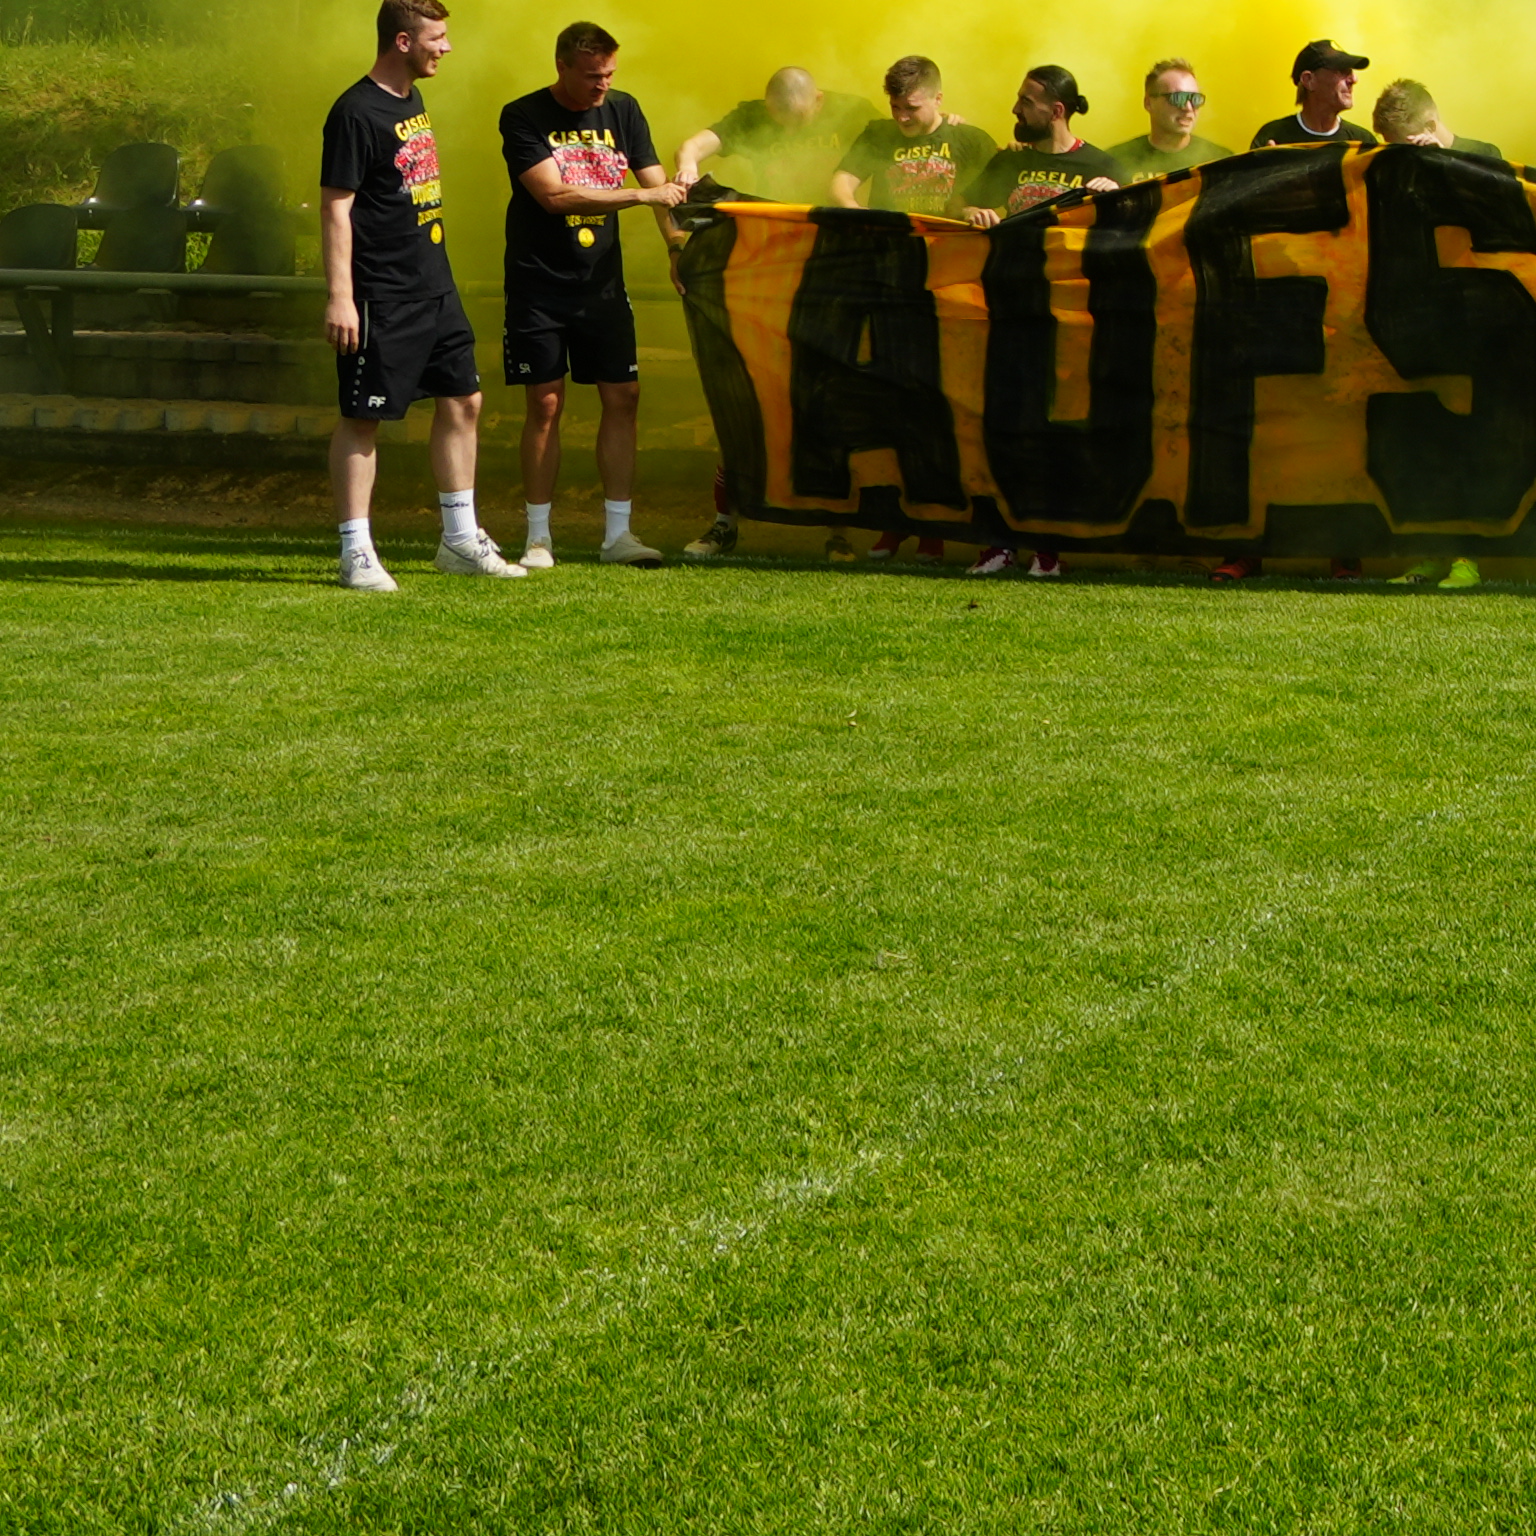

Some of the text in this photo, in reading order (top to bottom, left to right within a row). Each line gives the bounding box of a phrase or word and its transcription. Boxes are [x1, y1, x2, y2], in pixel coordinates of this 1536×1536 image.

[548, 129, 616, 149] GISELA
[893, 142, 951, 162] GISELA
[1017, 170, 1084, 189] GISELA
